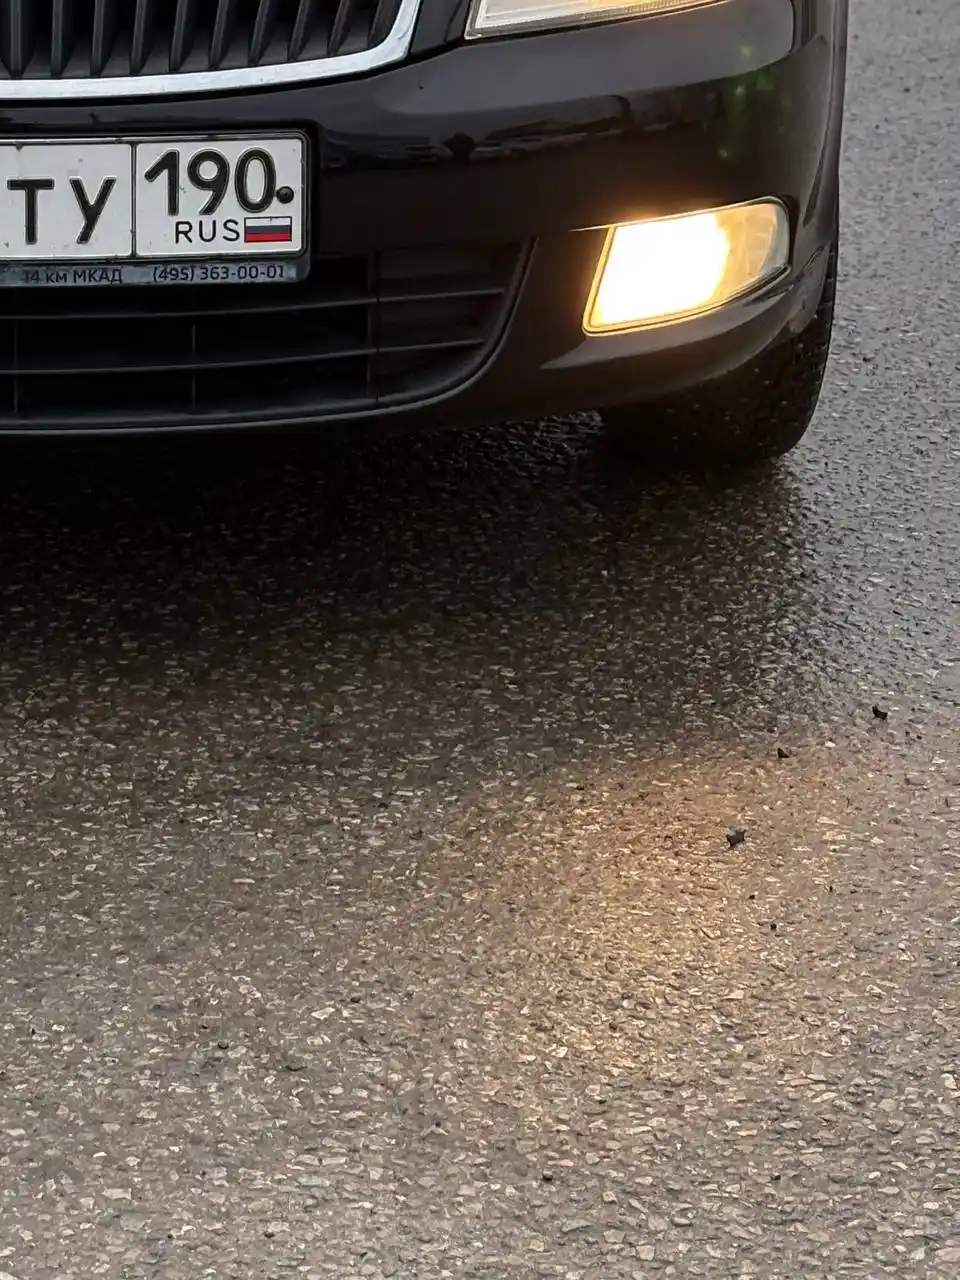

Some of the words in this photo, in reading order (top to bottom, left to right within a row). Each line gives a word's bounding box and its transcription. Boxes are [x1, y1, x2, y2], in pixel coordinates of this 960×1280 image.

[144, 147, 276, 216] 190
[175, 218, 240, 244] RUS
[73, 267, 124, 285] МКАД
[153, 265, 195, 283] (495)
[200, 264, 285, 281] 363-00-01
